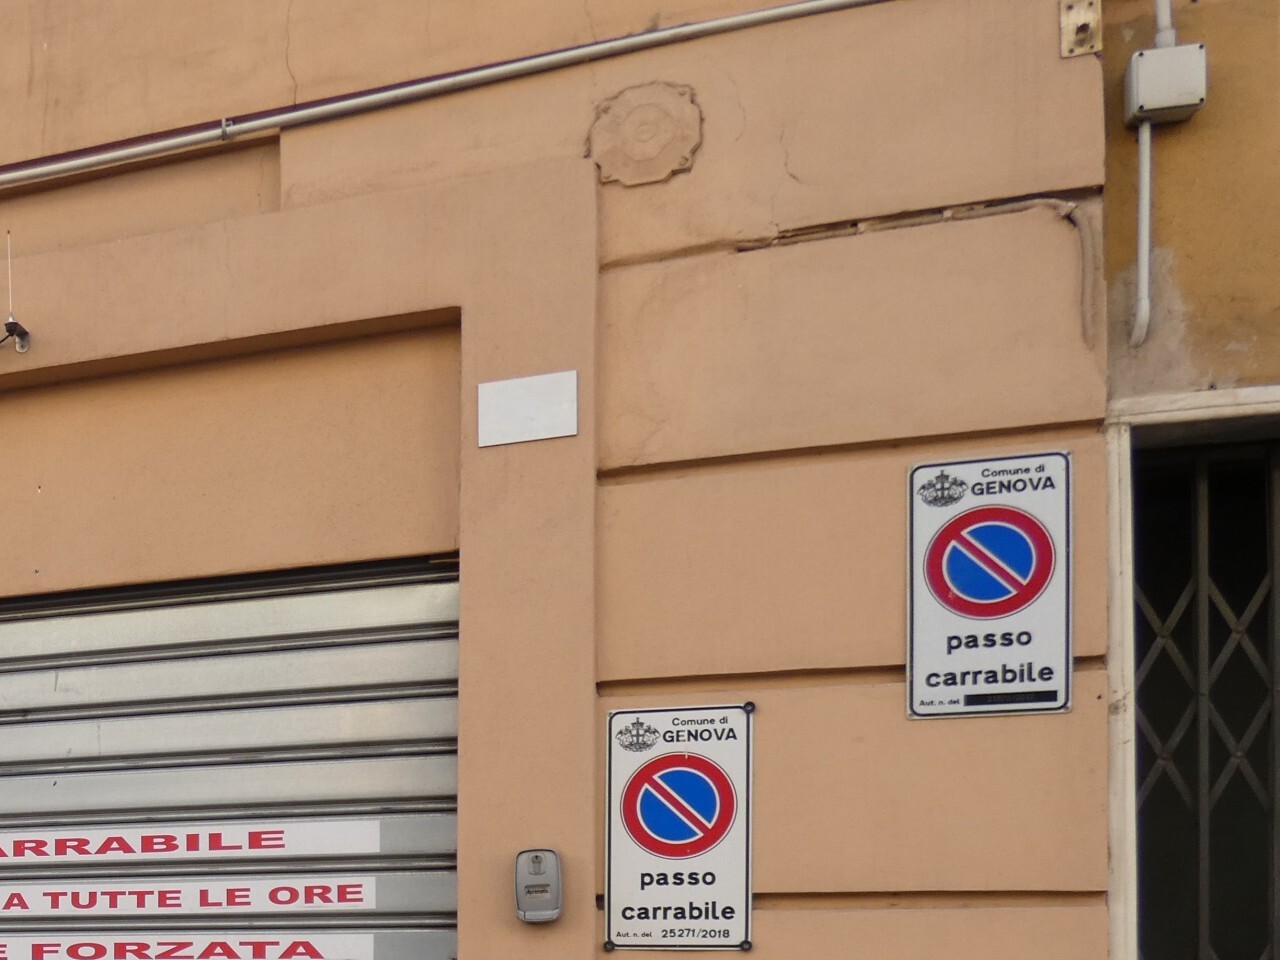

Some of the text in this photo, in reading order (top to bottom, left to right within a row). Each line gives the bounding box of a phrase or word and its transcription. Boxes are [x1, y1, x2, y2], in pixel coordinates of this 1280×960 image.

[981, 464, 1045, 478] Comune di
[971, 476, 1056, 496] GENOVA
[946, 630, 1033, 655] passo
[925, 662, 1055, 688] carrabile
[671, 715, 728, 727] Comune di
[662, 727, 738, 743] GENOVA
[640, 871, 716, 890] passo
[2, 892, 30, 911] A
[42, 889, 182, 910] TUTTE
[199, 887, 252, 907] LE
[268, 883, 364, 905] ORE
[621, 901, 735, 920] carrabile
[661, 928, 730, 939] 25271/2018
[31, 940, 325, 960] FORZATA
